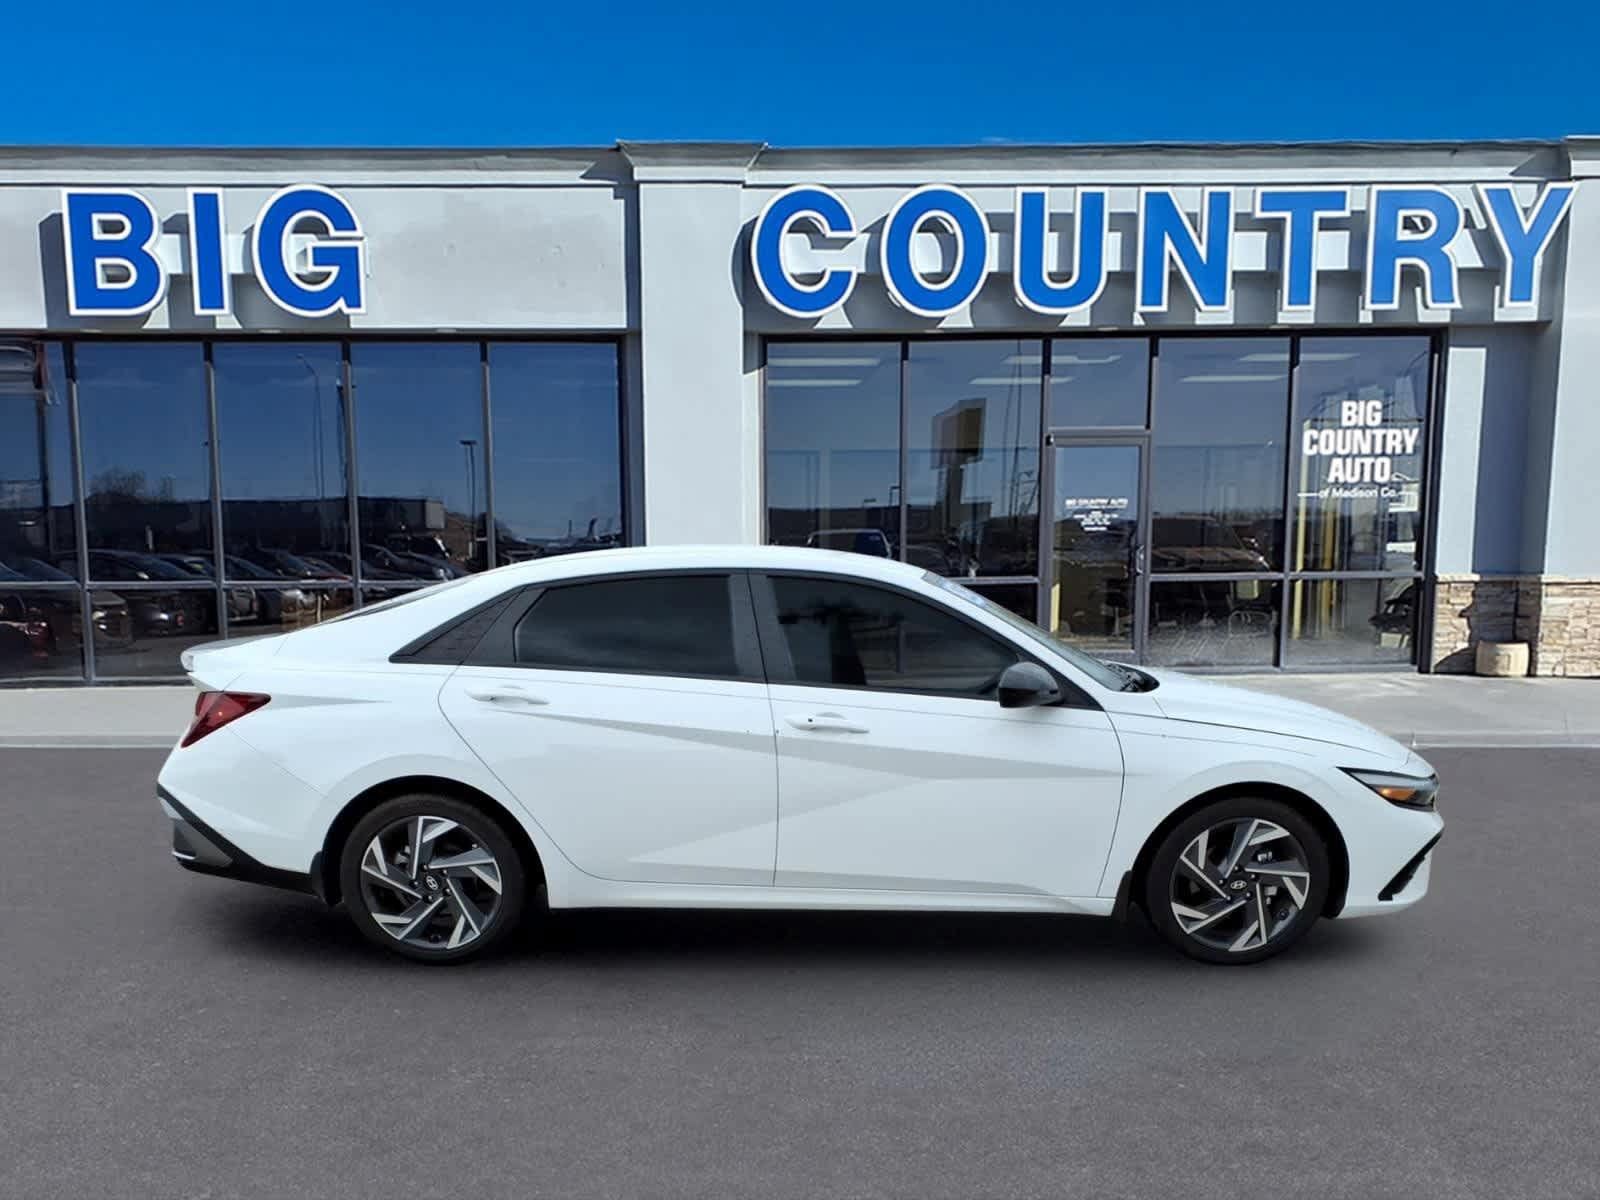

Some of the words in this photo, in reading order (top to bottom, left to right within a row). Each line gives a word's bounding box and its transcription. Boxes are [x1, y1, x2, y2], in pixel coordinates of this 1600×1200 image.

[61, 184, 367, 317] BIG
[750, 183, 1575, 319] COUNTRY
[1341, 400, 1382, 427] BIG
[1303, 428, 1419, 456] COUNTRY
[1327, 457, 1391, 483] AUTO
